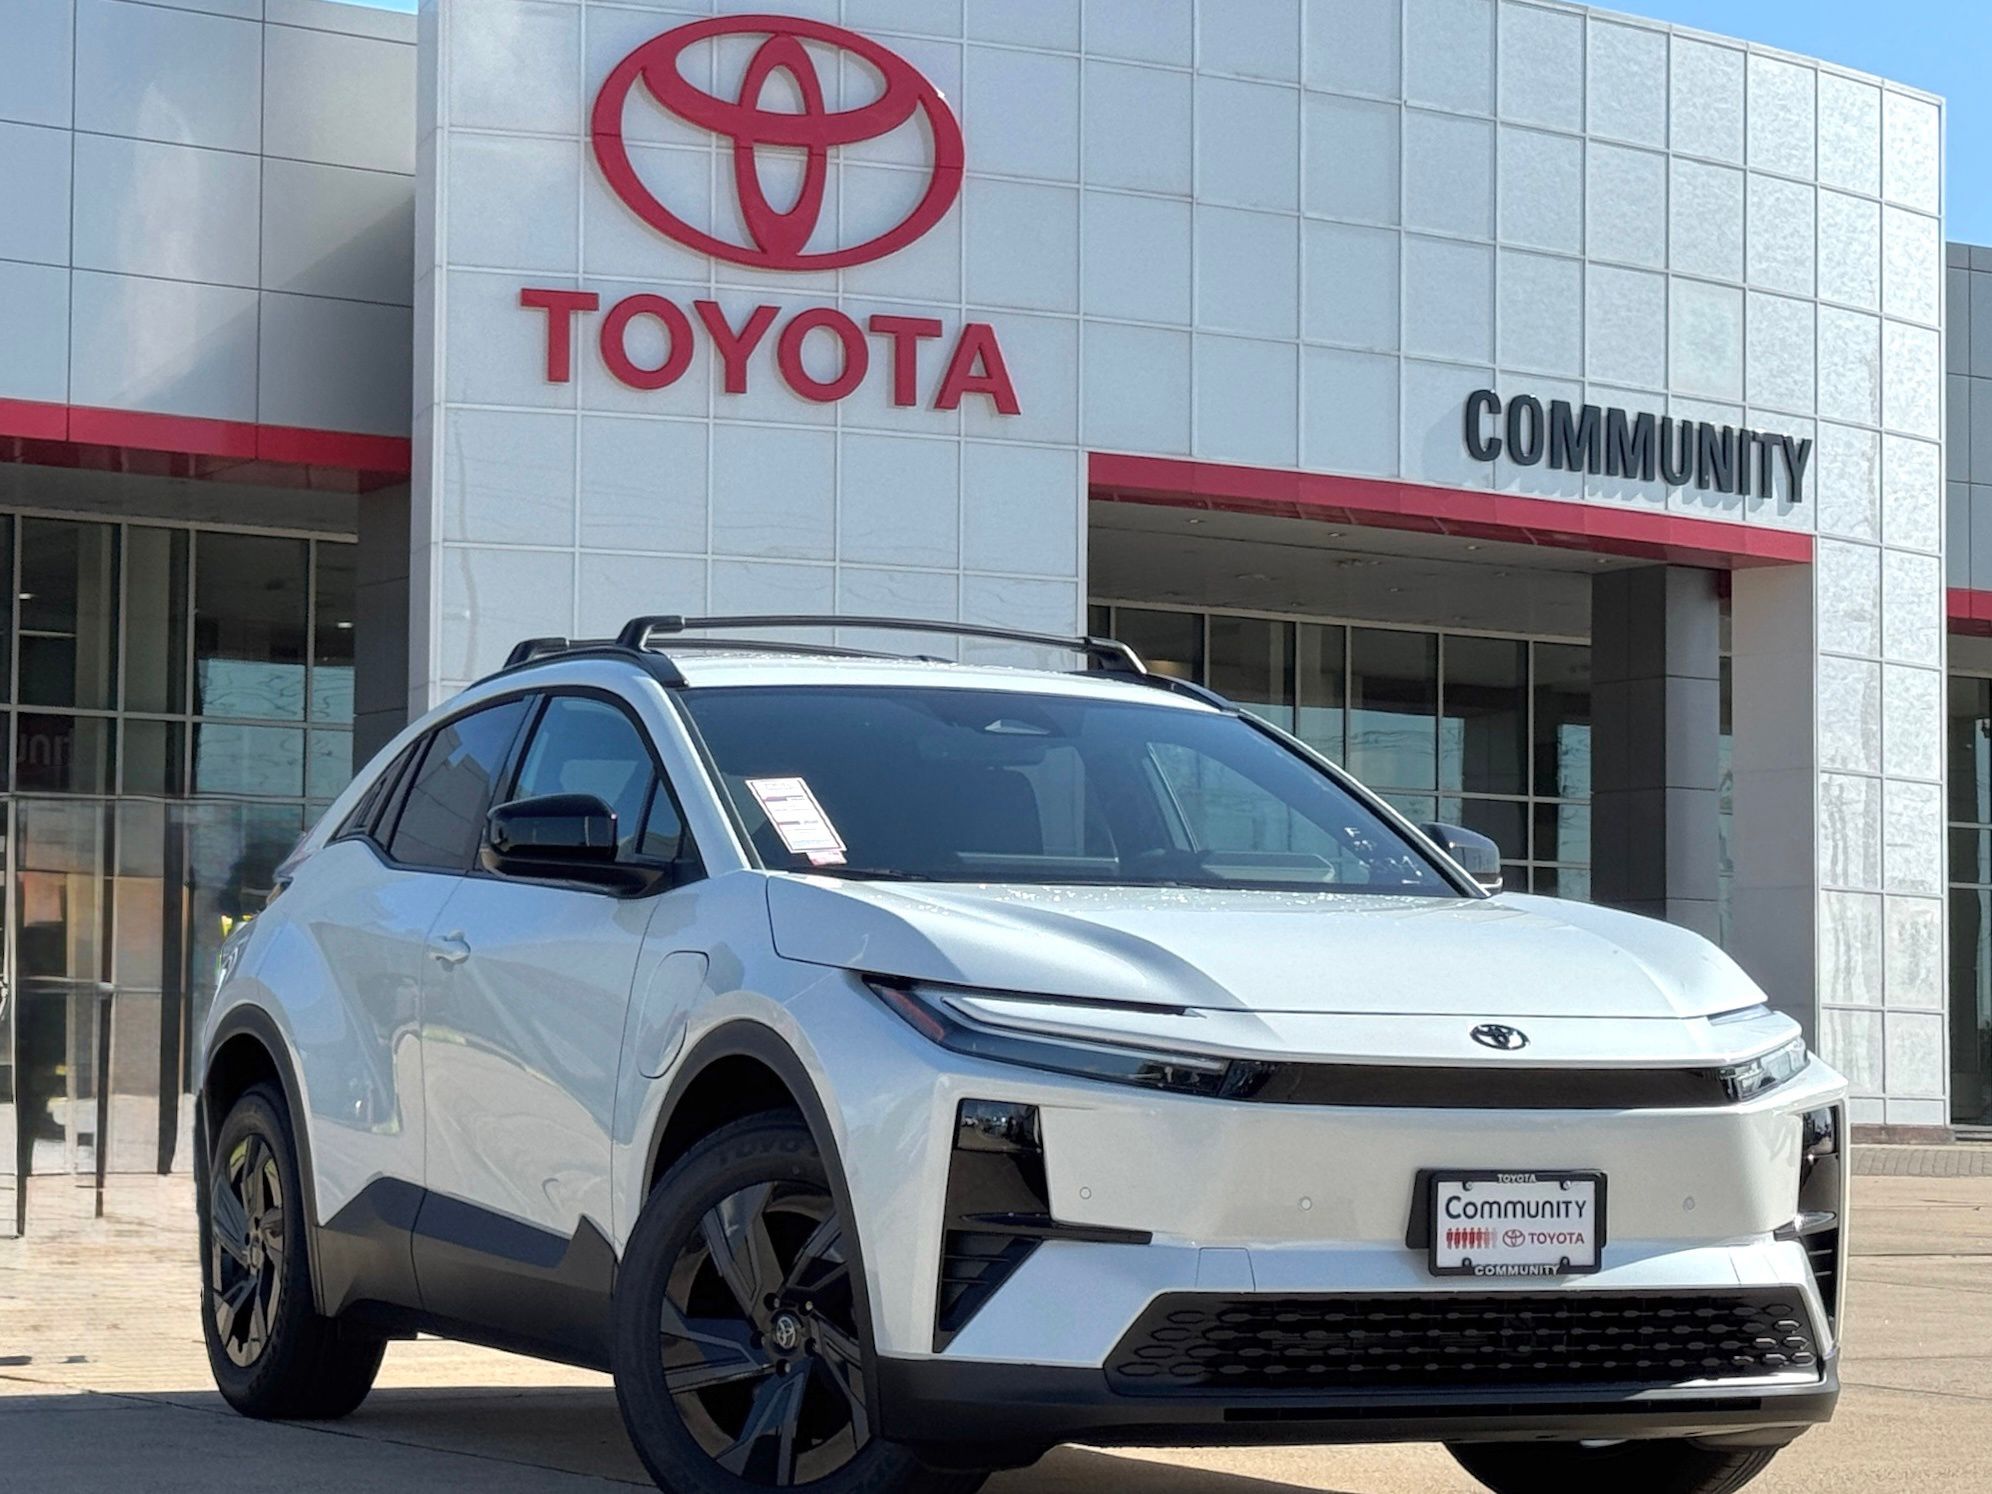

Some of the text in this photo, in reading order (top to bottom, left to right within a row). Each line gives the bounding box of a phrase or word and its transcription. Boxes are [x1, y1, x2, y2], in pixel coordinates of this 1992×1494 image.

[520, 288, 1021, 415] TOYOTA
[1465, 389, 1812, 503] COMMUNITY
[1497, 1173, 1537, 1184] TOYOTA
[1528, 1232, 1585, 1245] TOYOTA
[1474, 1264, 1561, 1276] COMMUNITY
